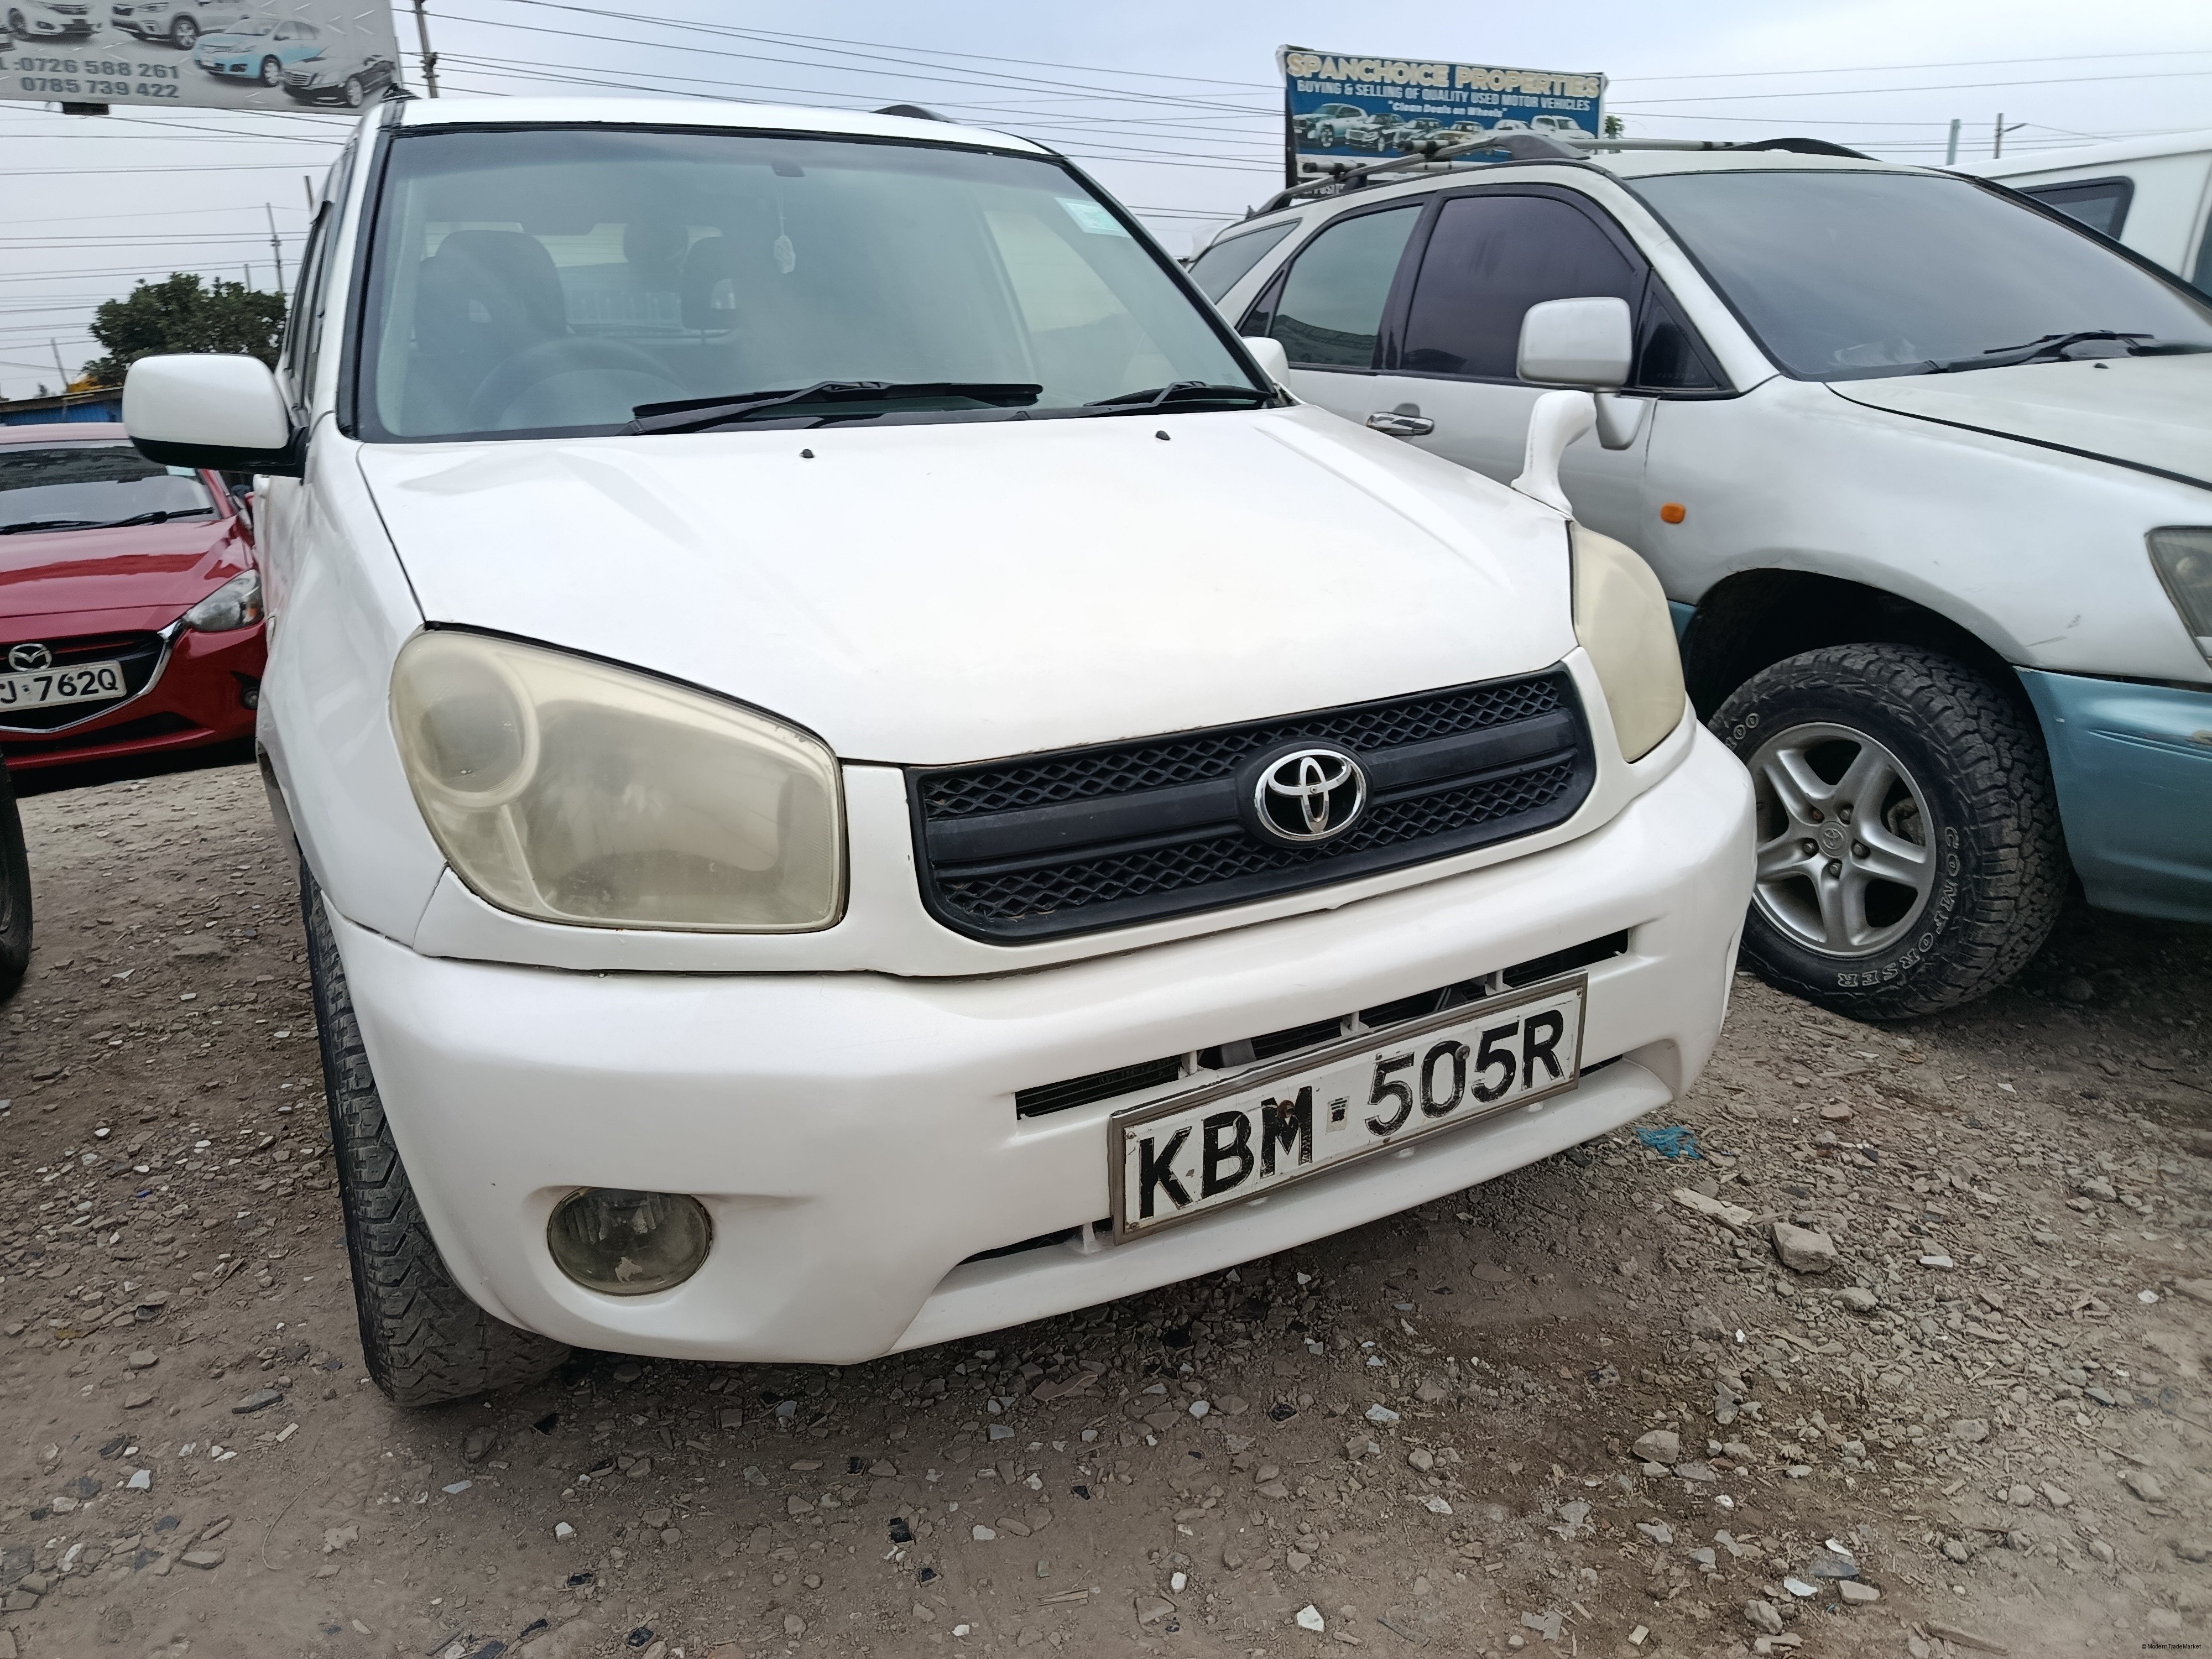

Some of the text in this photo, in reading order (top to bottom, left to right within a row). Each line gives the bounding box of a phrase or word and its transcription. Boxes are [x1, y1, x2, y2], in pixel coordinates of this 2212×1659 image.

[85, 61, 131, 76] 588
[138, 63, 179, 79] 261
[1287, 53, 1600, 98] SPANCHOICE PROPERTIES
[20, 77, 180, 98] 0785 739 422
[1297, 80, 1591, 111] BUYING & SELLING OF QUALITY USED MOTOR VEHICLES
[33, 668, 119, 702] 762Q
[1838, 826, 1960, 987] COMFORSER
[1139, 1009, 1565, 1220] KBM 505R
